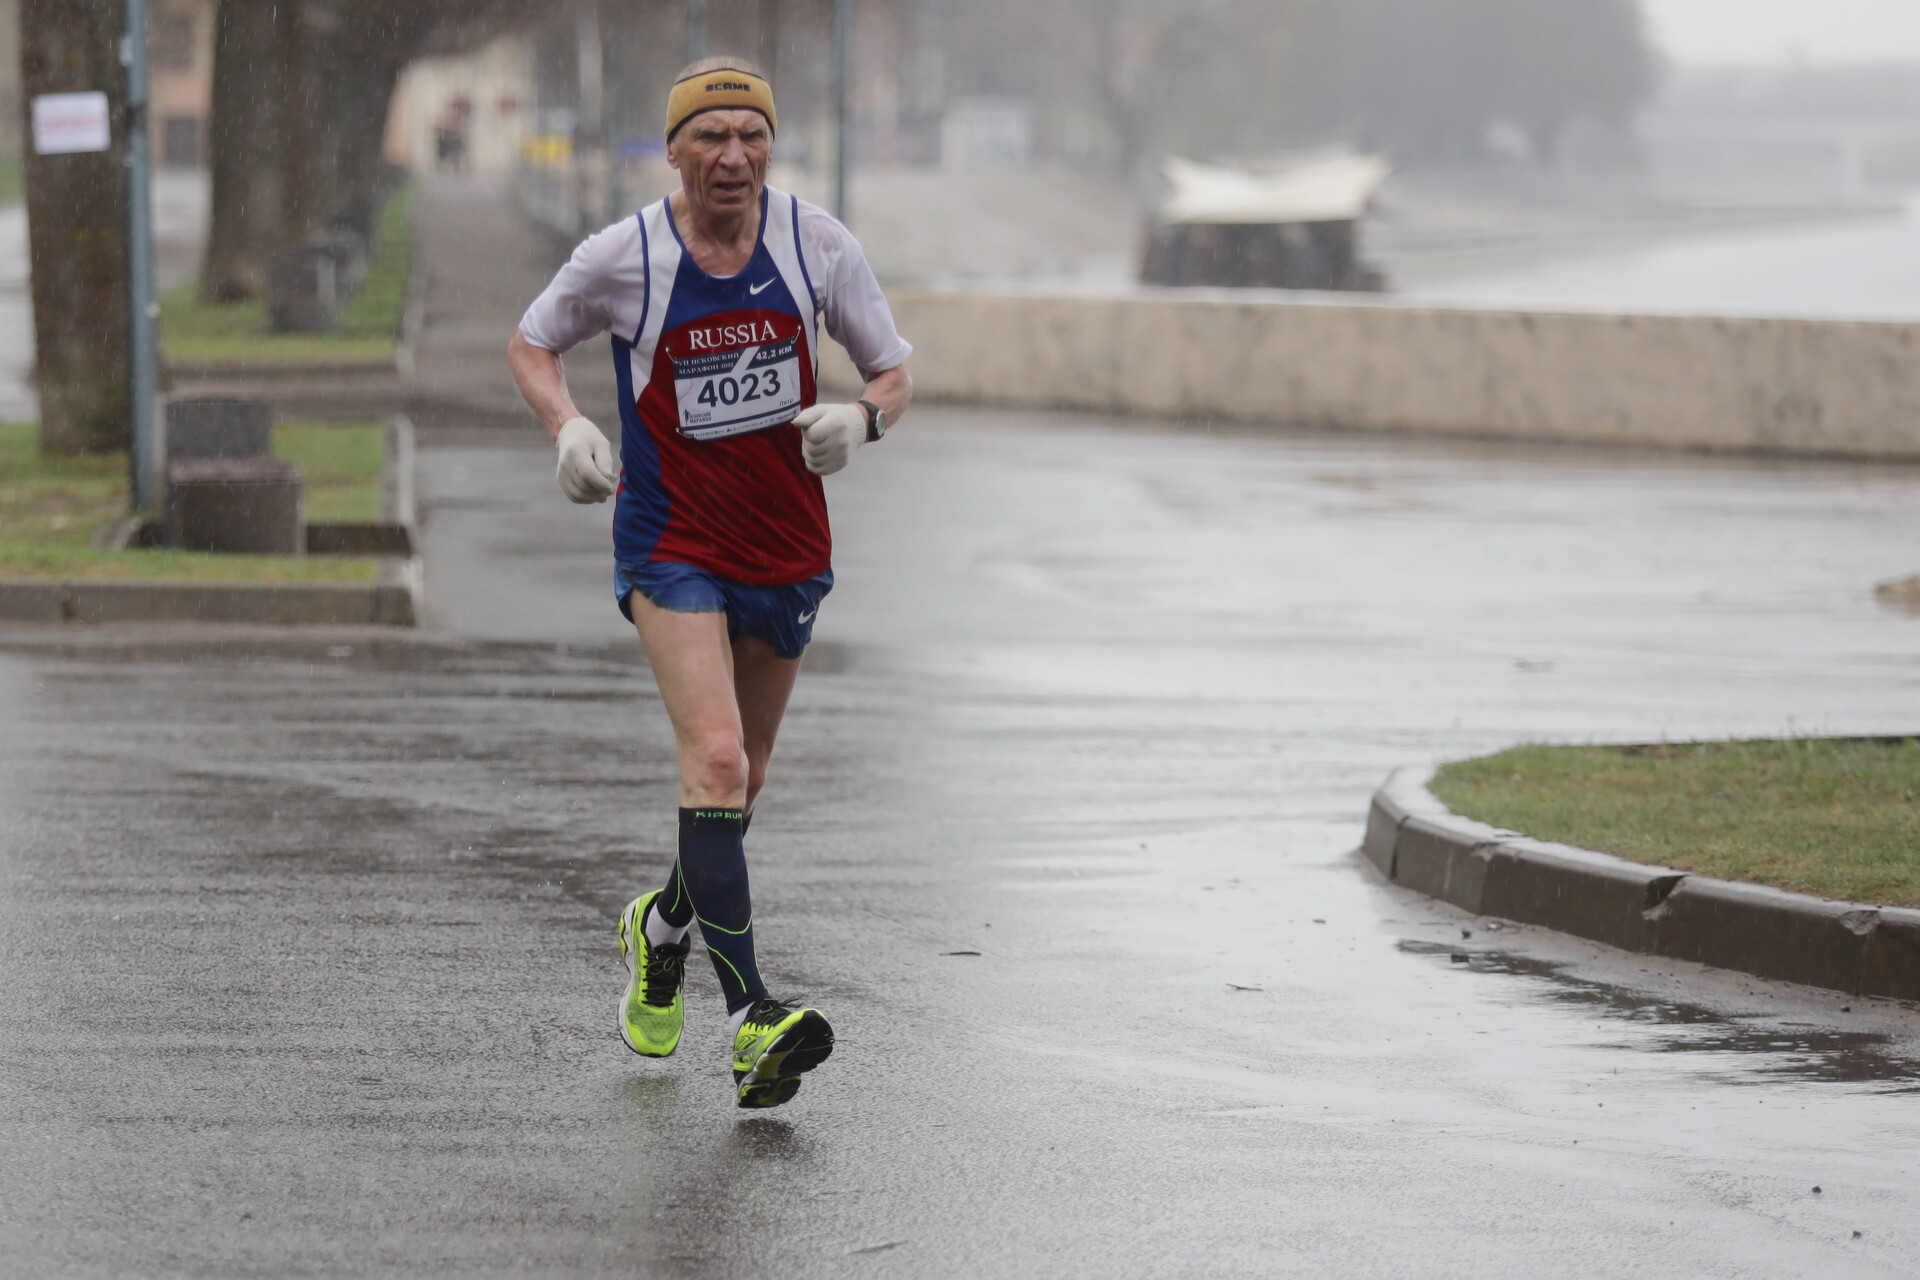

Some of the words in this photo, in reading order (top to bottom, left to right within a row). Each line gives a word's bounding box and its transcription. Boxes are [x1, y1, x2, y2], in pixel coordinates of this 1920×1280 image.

[705, 82, 751, 92] SCAME
[688, 320, 778, 350] RUSSIA
[691, 352, 740, 365] ПСКОВСКИЙ
[755, 350, 777, 361] 42,2
[678, 364, 719, 375] МАРАФОН
[697, 368, 781, 408] 4023
[779, 398, 794, 407] Петр
